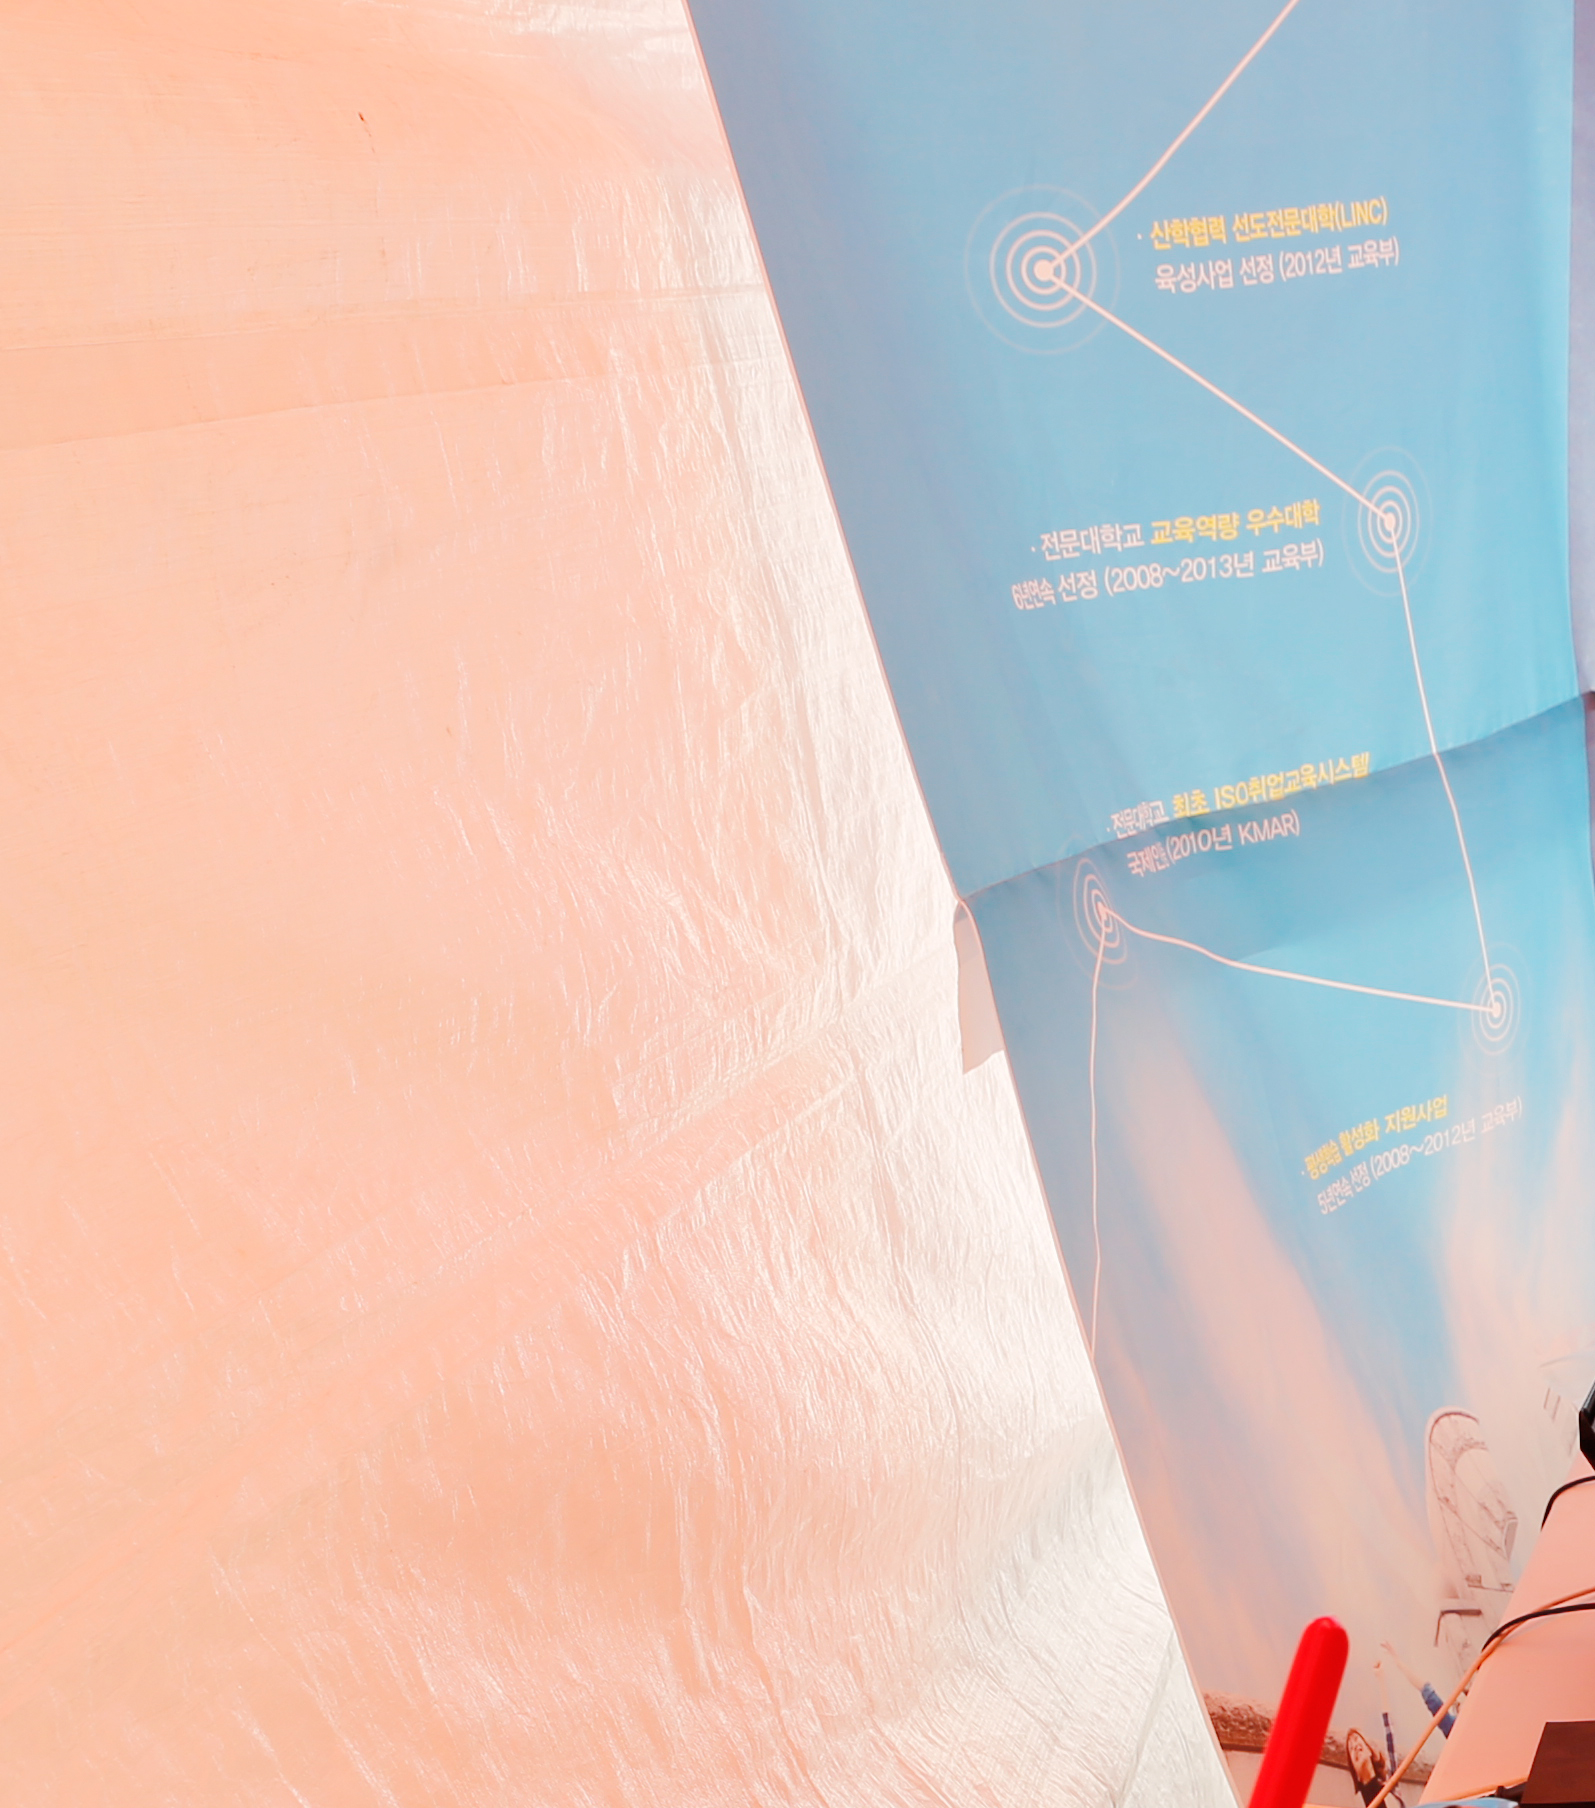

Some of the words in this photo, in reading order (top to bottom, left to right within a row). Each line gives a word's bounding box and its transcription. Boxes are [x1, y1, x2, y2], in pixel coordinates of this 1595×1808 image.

[1150, 215, 1227, 250] 산학협력
[1232, 195, 1388, 242] 선도전문대학(LINC)
[1155, 258, 1234, 294] 육성사업
[1239, 254, 1274, 286] 선정
[1279, 245, 1342, 282] (2012년
[1348, 236, 1400, 269] 교육부)
[1040, 522, 1145, 561] 전문대학교
[1150, 512, 1240, 545] 교육역량
[1245, 498, 1320, 536] 우수대학
[1058, 569, 1099, 602] 선정
[1103, 550, 1254, 597] (2008~2013년
[1261, 537, 1325, 573] 교육부)
[1172, 788, 1211, 818] 최초
[1213, 751, 1371, 810] ISO취업교육시스템
[1338, 1118, 1381, 1156] 활성화
[1384, 1094, 1448, 1133] 지원사업
[1481, 1096, 1523, 1133] 교육부)
